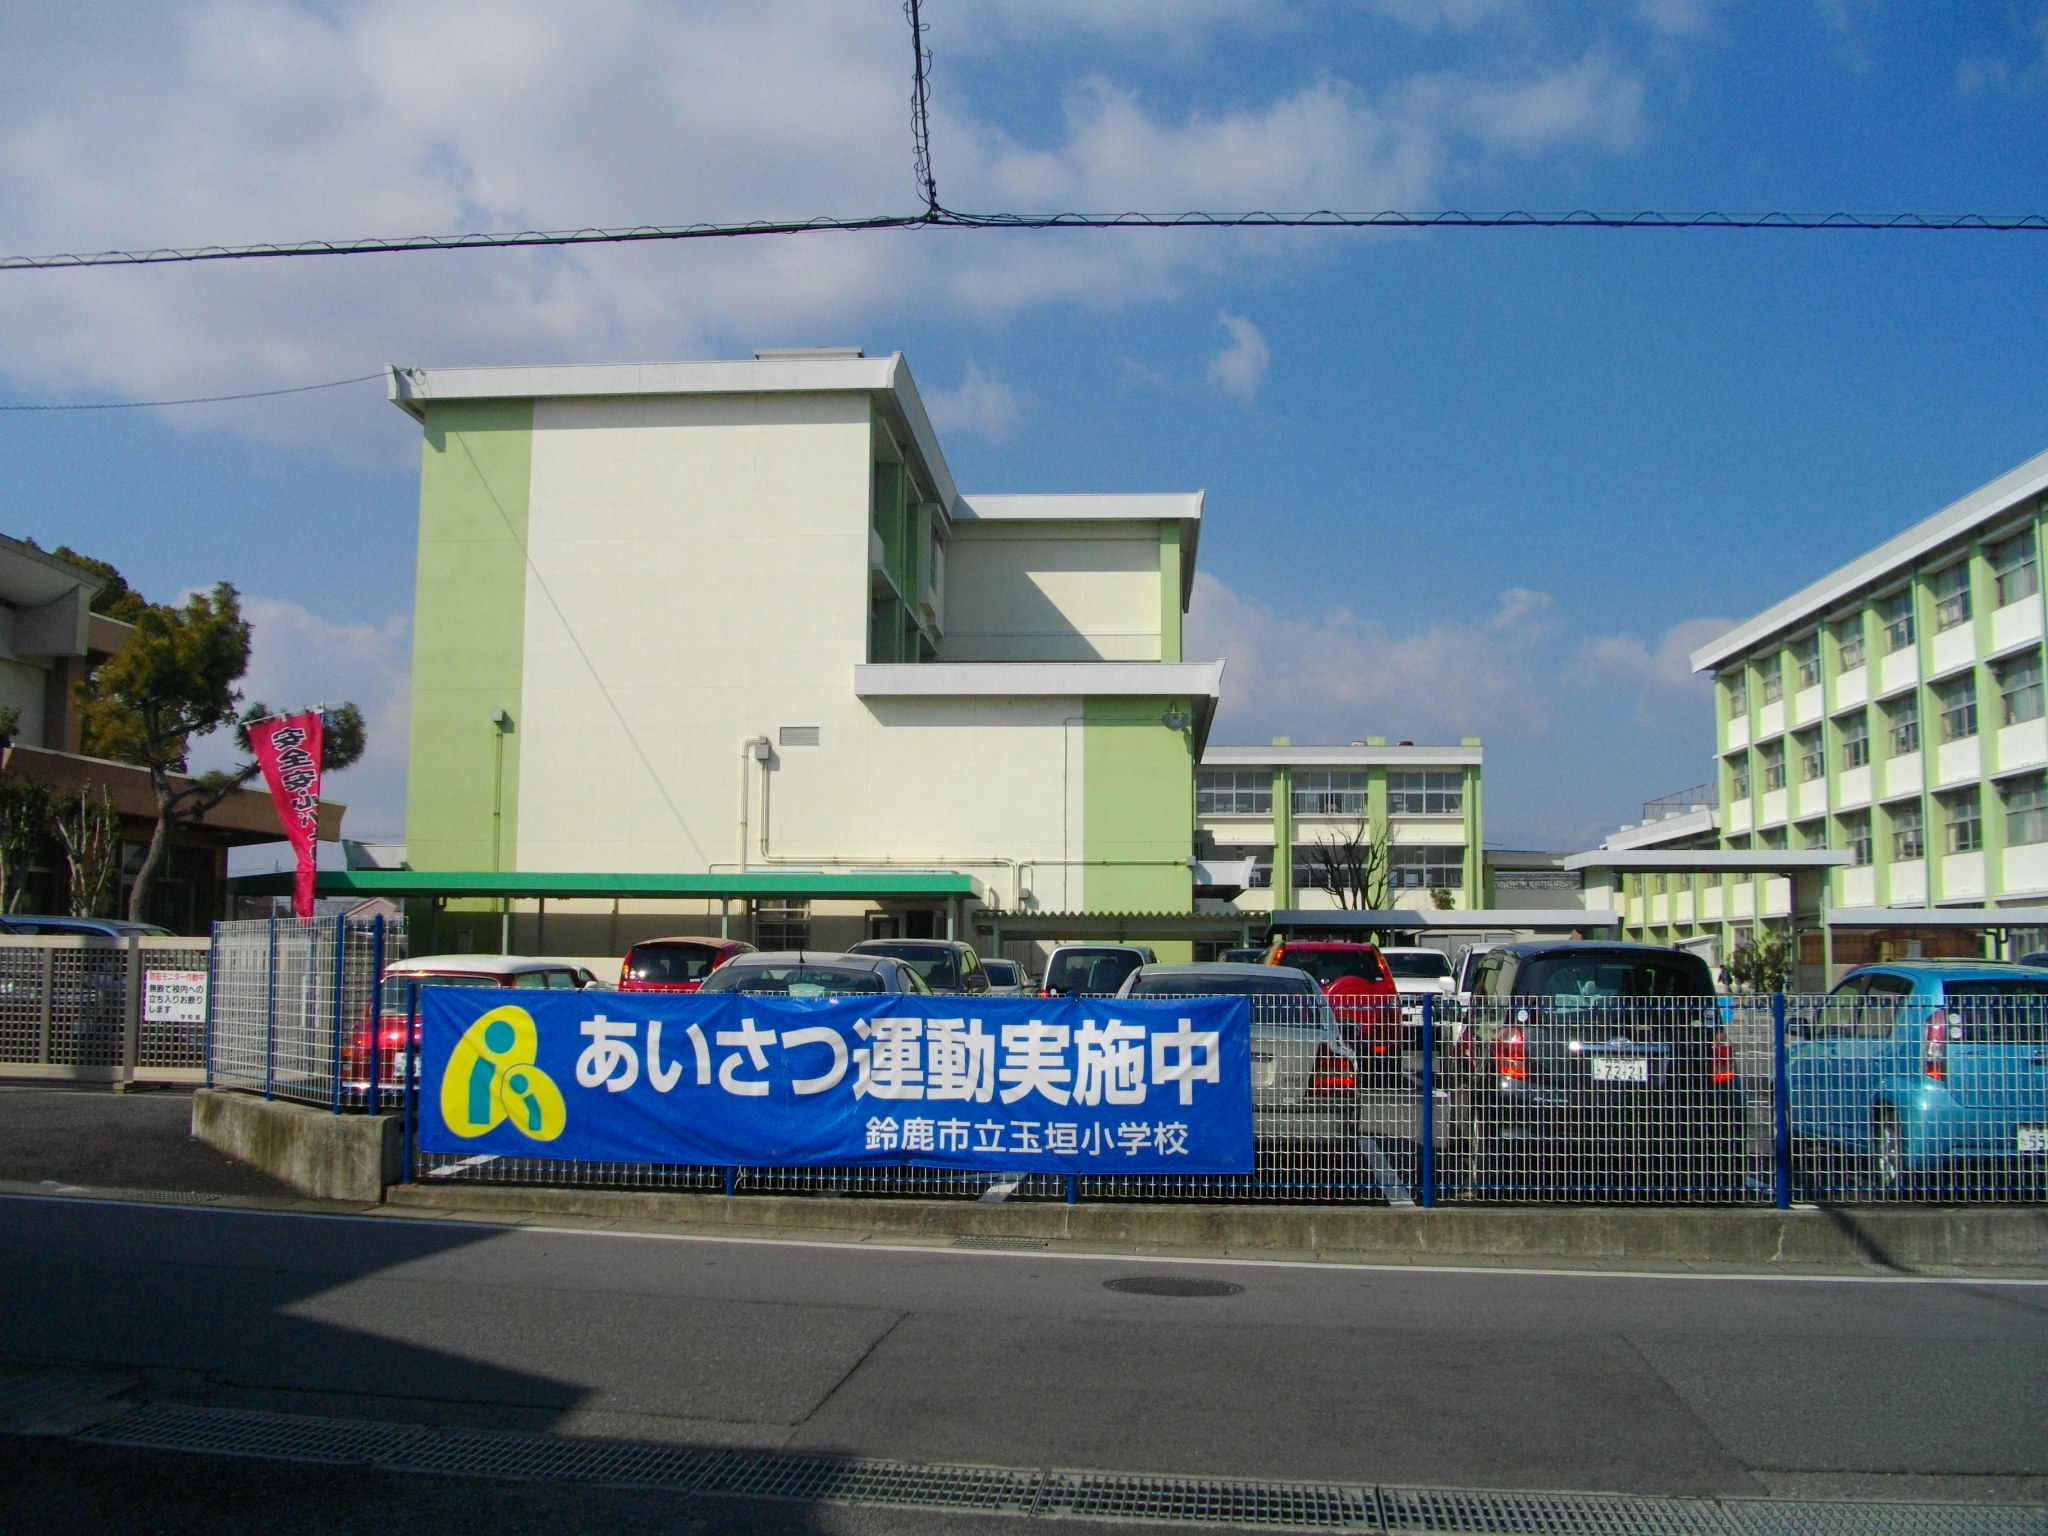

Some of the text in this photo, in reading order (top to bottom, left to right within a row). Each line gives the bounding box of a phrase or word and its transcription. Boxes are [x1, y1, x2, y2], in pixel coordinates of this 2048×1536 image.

[149, 984, 204, 994] 無断で校内への
[149, 995, 203, 1005] 立ち入りお断り
[149, 1005, 172, 1014] します
[576, 1015, 1222, 1107] あいさつ運動実施中
[865, 1116, 1189, 1158] 鈴鹿市立玉垣小学校
